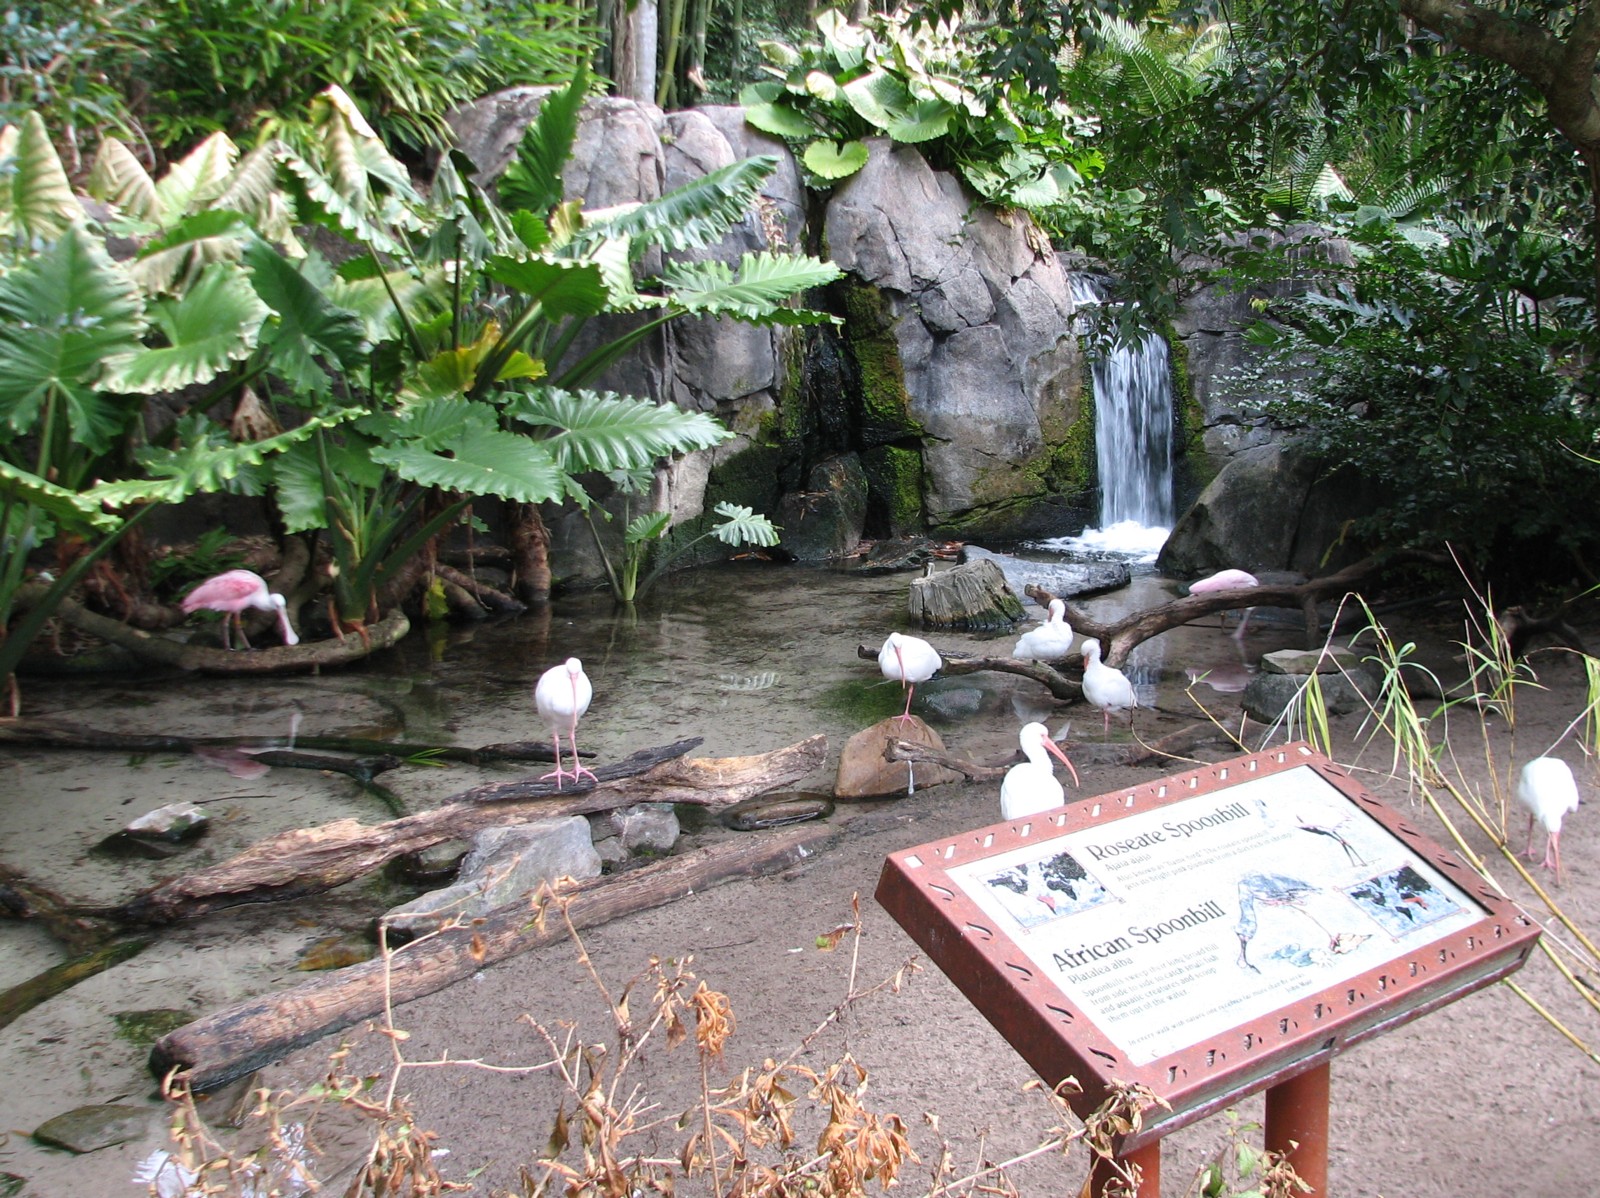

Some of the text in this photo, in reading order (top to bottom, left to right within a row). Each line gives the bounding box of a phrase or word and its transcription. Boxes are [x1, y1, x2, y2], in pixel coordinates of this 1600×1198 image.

[1084, 801, 1250, 861] Roseate Spoonbill
[1052, 899, 1226, 972] African Spoonbill
[1066, 956, 1134, 984] Platalea alba
[1081, 977, 1124, 998] Spoonbills
[1124, 970, 1150, 982] sweep
[1090, 994, 1111, 1005] from
[1110, 988, 1128, 998] side
[1127, 984, 1138, 992] to
[1138, 978, 1154, 988] side
[1162, 966, 1184, 978] catch
[1182, 958, 1203, 971] small
[1202, 954, 1219, 964] fish
[1098, 966, 1218, 1014] and aquatic creatures and scoop
[1106, 1011, 1129, 1022] them
[1128, 1006, 1144, 1014] out
[1142, 1001, 1152, 1009] of
[1150, 997, 1166, 1006] the
